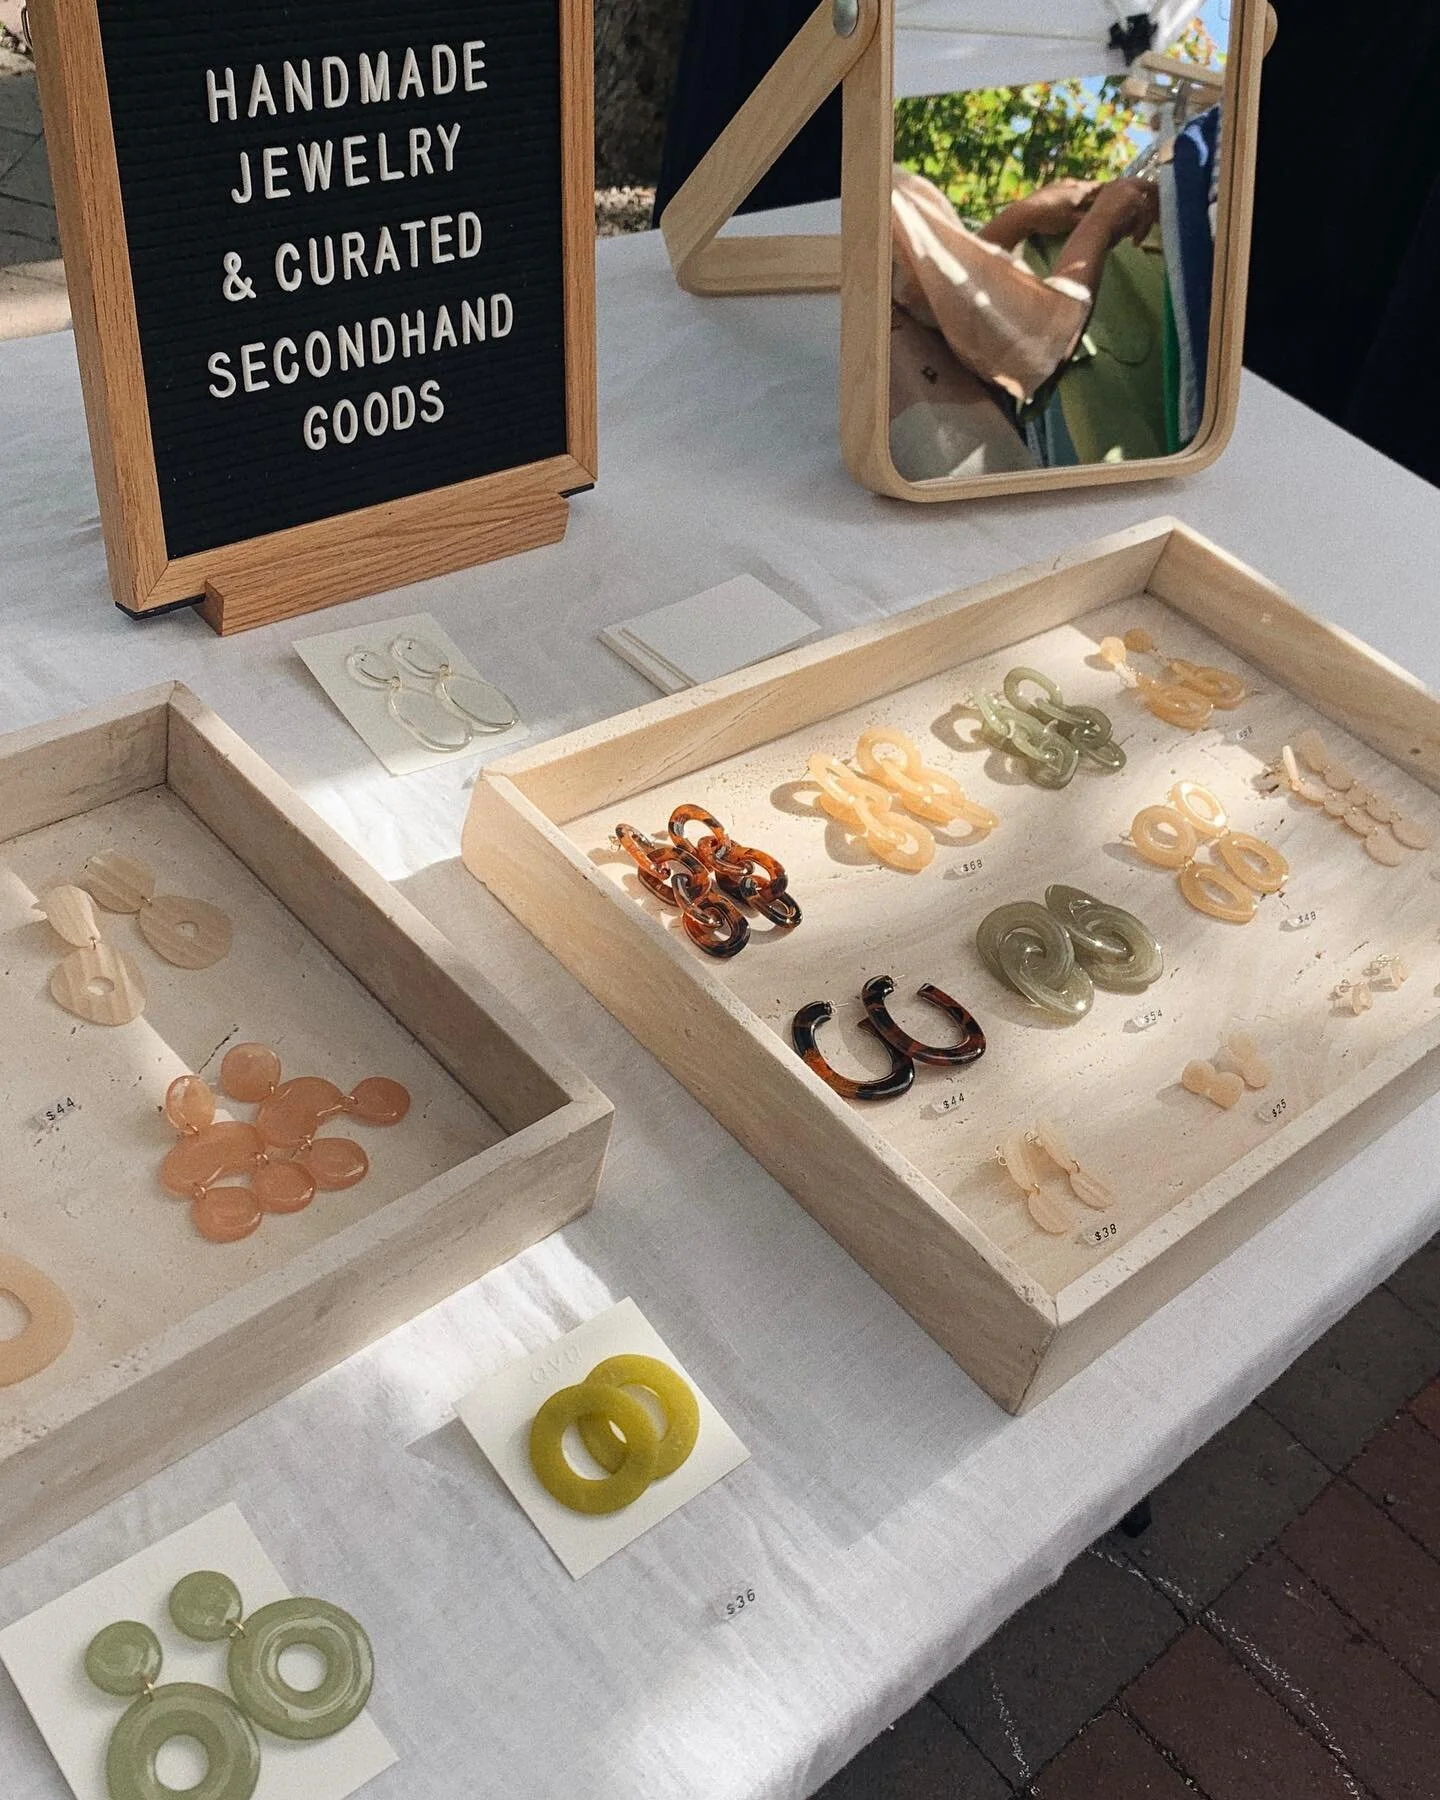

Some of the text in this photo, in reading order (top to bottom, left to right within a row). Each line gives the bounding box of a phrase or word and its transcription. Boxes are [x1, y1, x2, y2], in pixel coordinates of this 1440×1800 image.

[206, 40, 488, 123] HANDMADE
[231, 122, 461, 204] JEWELRY
[222, 211, 482, 302] & CURATED
[207, 293, 514, 398] SECONDHAND
[303, 379, 445, 450] GOODS
[962, 858, 983, 872] $68
[1143, 1009, 1162, 1023] $54
[45, 1097, 76, 1121] $44
[942, 1092, 964, 1109] $44
[1271, 1098, 1287, 1118] $25
[1094, 1223, 1117, 1241] $38
[726, 1588, 756, 1615] $36
